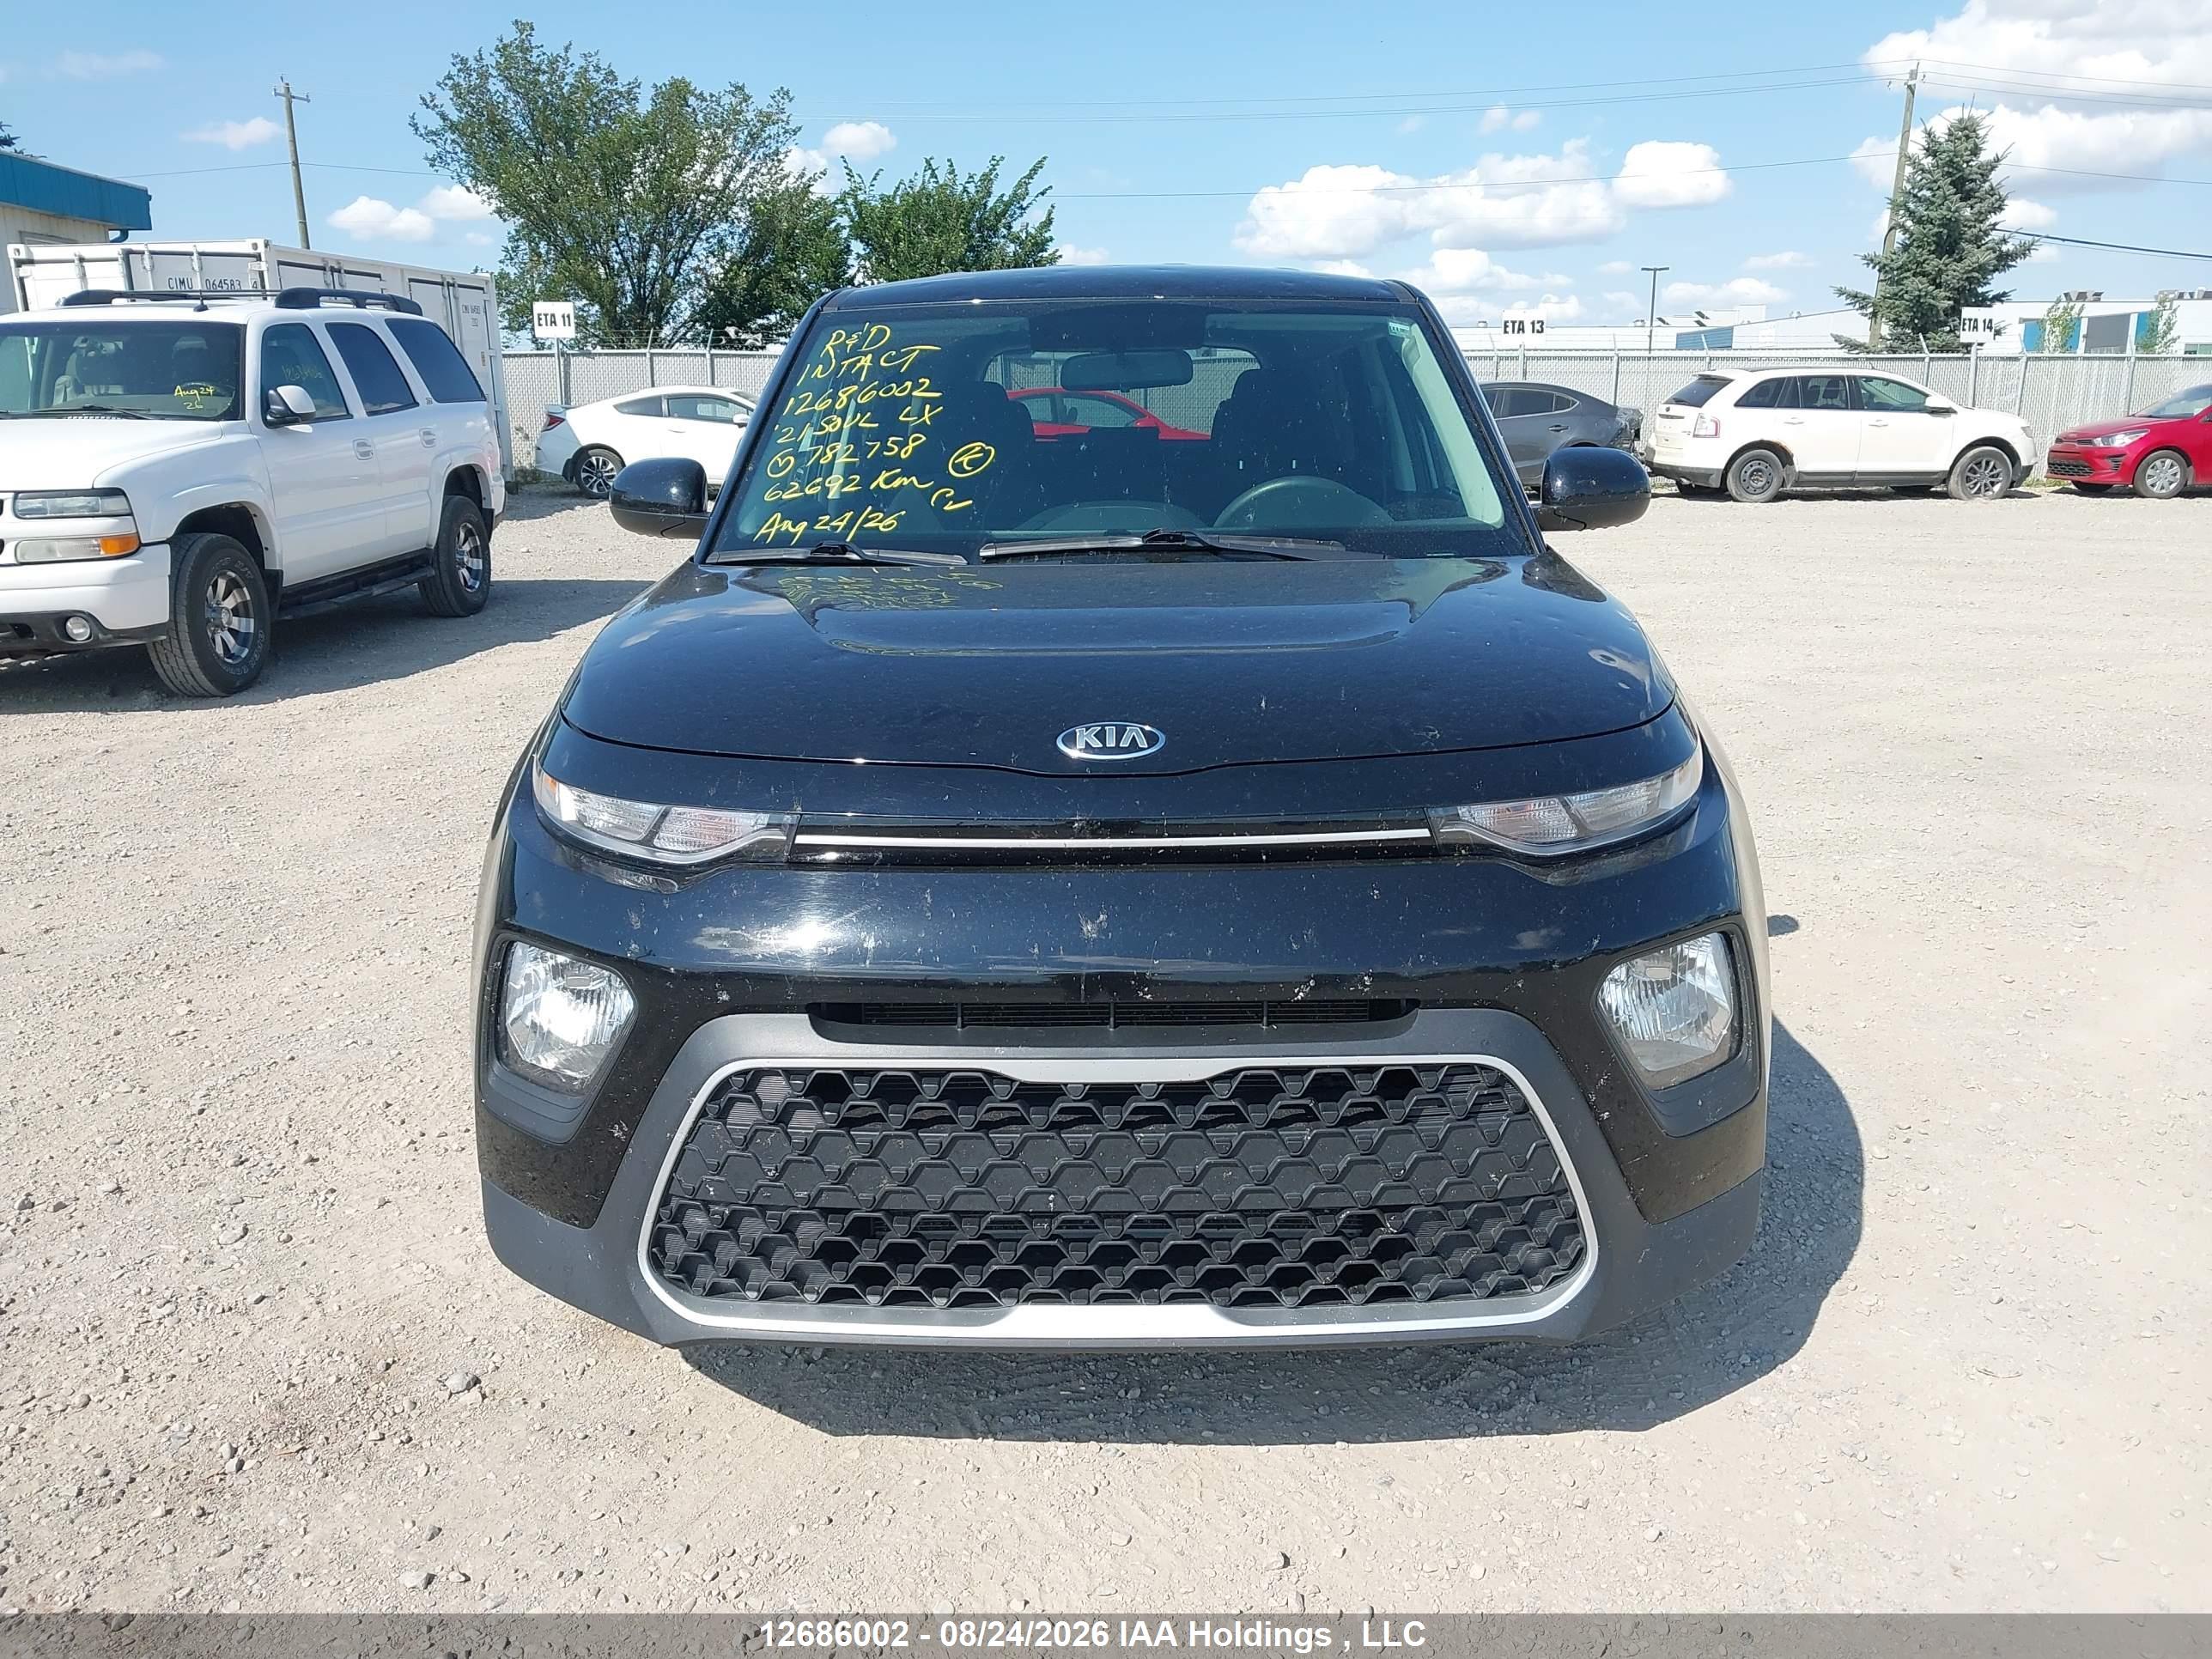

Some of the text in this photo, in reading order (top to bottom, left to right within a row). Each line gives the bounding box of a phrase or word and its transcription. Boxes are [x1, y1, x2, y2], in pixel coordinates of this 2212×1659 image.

[167, 277, 193, 289] CIMU
[537, 313, 571, 327] ETA 11
[1504, 319, 1545, 335] ETA 13
[1961, 317, 1994, 332] ETA 14
[796, 345, 942, 386] INTACT
[174, 385, 200, 402] Aug
[782, 377, 943, 416] 12686002
[899, 404, 943, 427] LX
[764, 474, 863, 501] 62692
[1075, 726, 1148, 749] KIA
